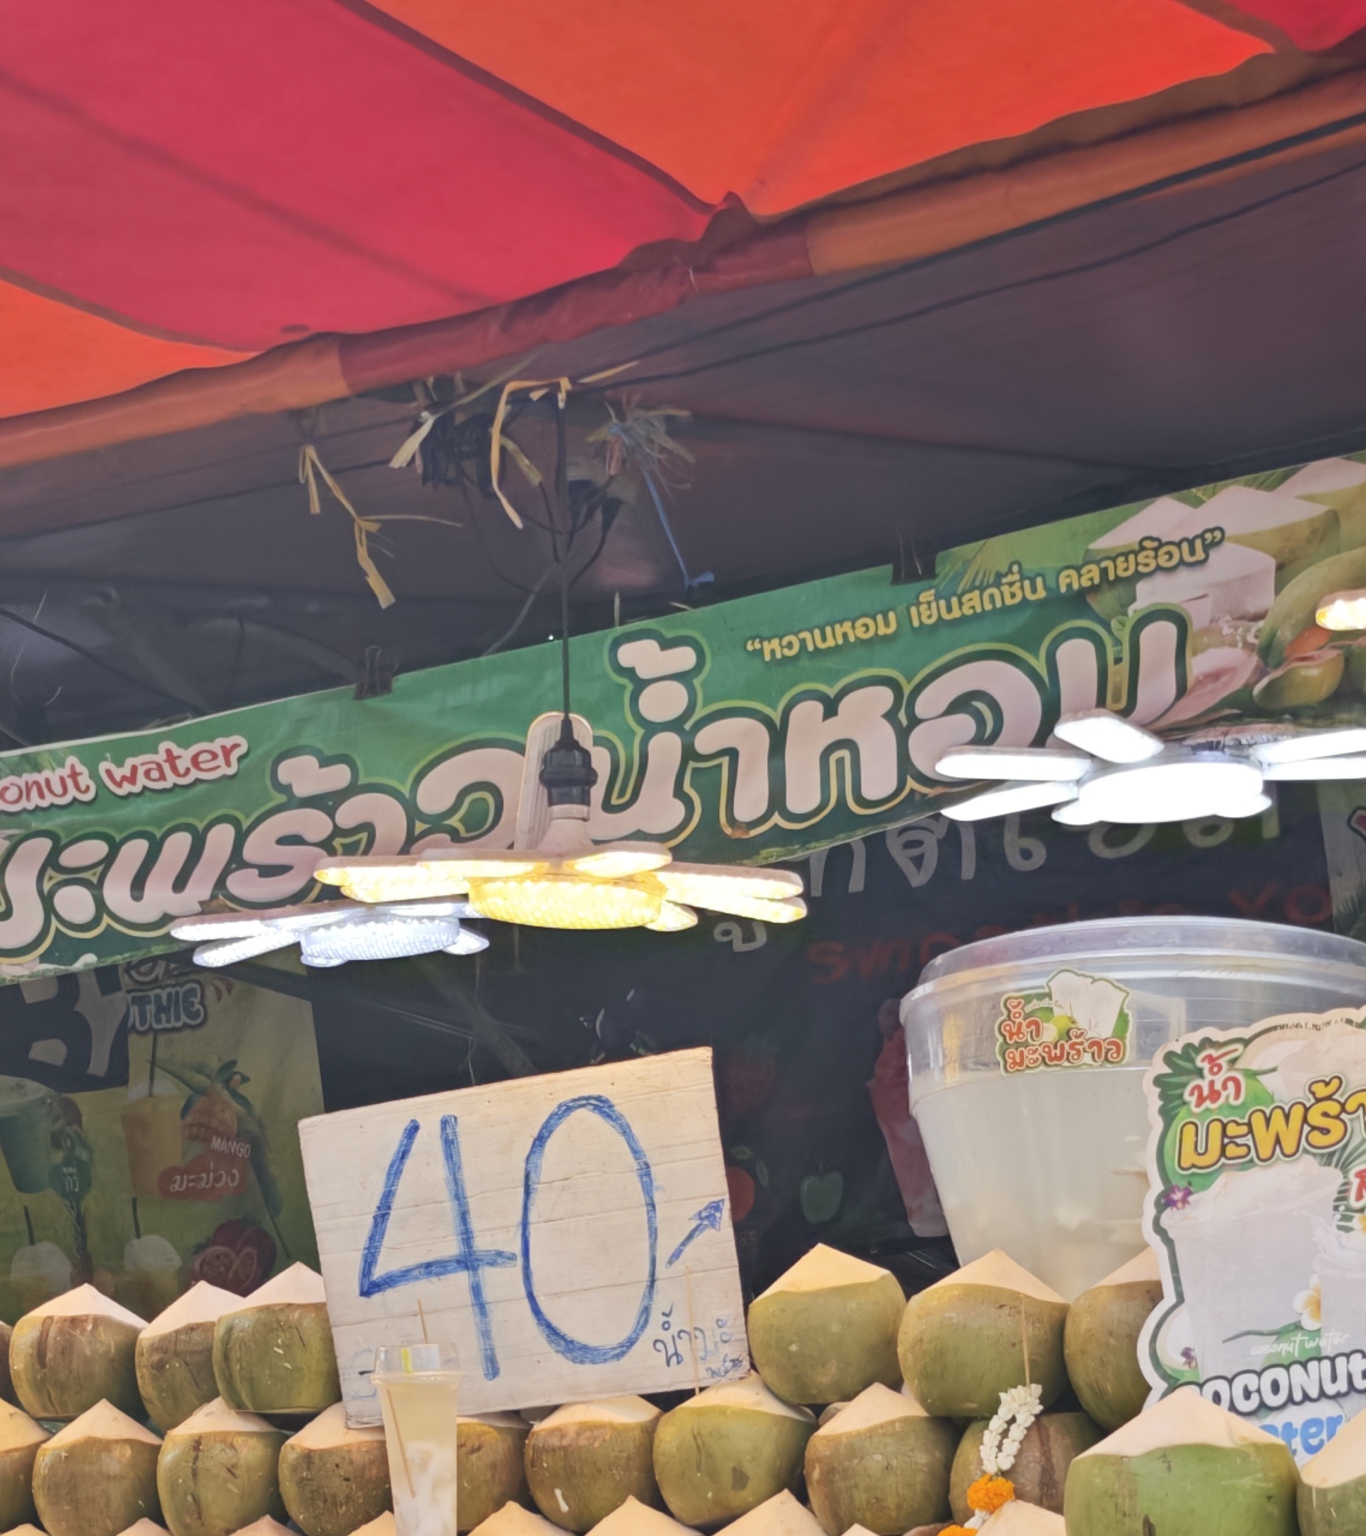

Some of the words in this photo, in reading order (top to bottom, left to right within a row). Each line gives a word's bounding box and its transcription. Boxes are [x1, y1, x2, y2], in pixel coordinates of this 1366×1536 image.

[910, 565, 1046, 628] เย็นสดชื่น
[105, 737, 244, 794] water
[1001, 999, 1042, 1044] น้ำ
[1005, 1029, 1124, 1072] มะพร้าว
[1188, 1046, 1243, 1109] น้ำ
[170, 1161, 240, 1192] มะม่วง
[359, 1095, 657, 1382] 40
